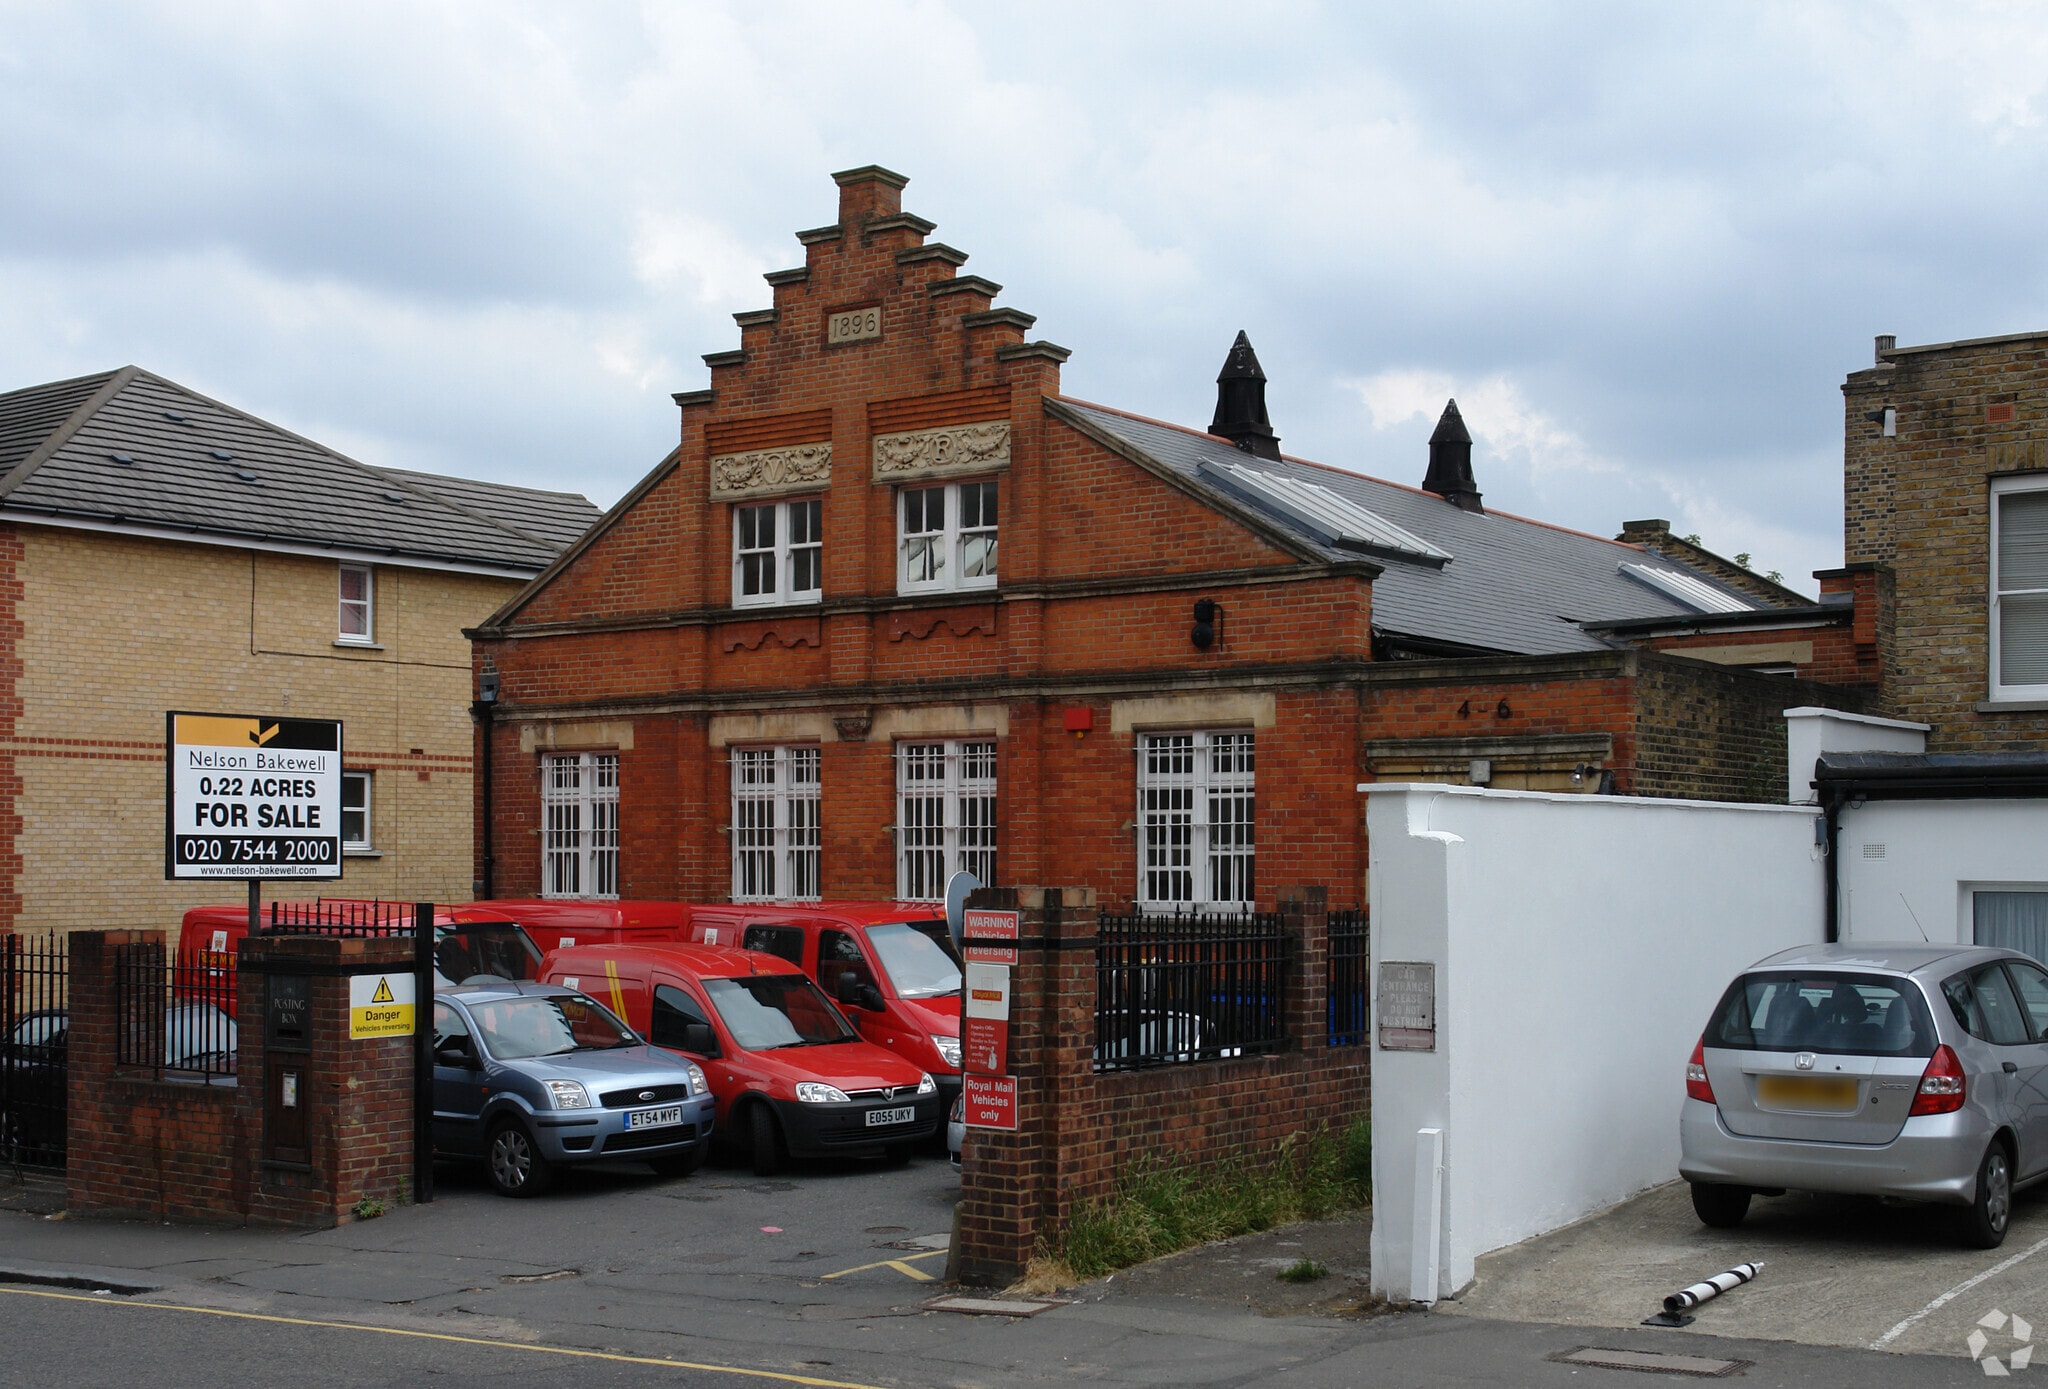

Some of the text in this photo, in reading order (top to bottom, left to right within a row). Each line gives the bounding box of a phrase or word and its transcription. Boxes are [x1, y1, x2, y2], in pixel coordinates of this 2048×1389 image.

[833, 312, 876, 339] 1896
[190, 750, 326, 771] Nelson Bakewell
[200, 777, 316, 798] 0.22 ACRES
[196, 802, 321, 829] FOR SALE
[185, 839, 330, 861] 020 7544 2000
[200, 864, 317, 875] www.nelson-bakewell.com
[968, 915, 1015, 929] WARNING
[1397, 969, 1416, 980] CAR
[1382, 980, 1430, 992] ENTRANCE
[274, 998, 305, 1010] POSTING
[1390, 993, 1422, 1004] PLEASE
[1390, 1004, 1422, 1015] DO NOT
[281, 1012, 297, 1024] BOX
[365, 1010, 401, 1022] Danger
[1382, 1015, 1429, 1027] OBSTRUCT
[355, 1023, 410, 1032] Vehicles reversing
[967, 1079, 1013, 1093] Royal Mail
[972, 1094, 1008, 1107] Vehicles
[631, 1109, 679, 1126] ET54 MYF
[894, 1108, 911, 1121] UKY
[980, 1110, 999, 1122] only
